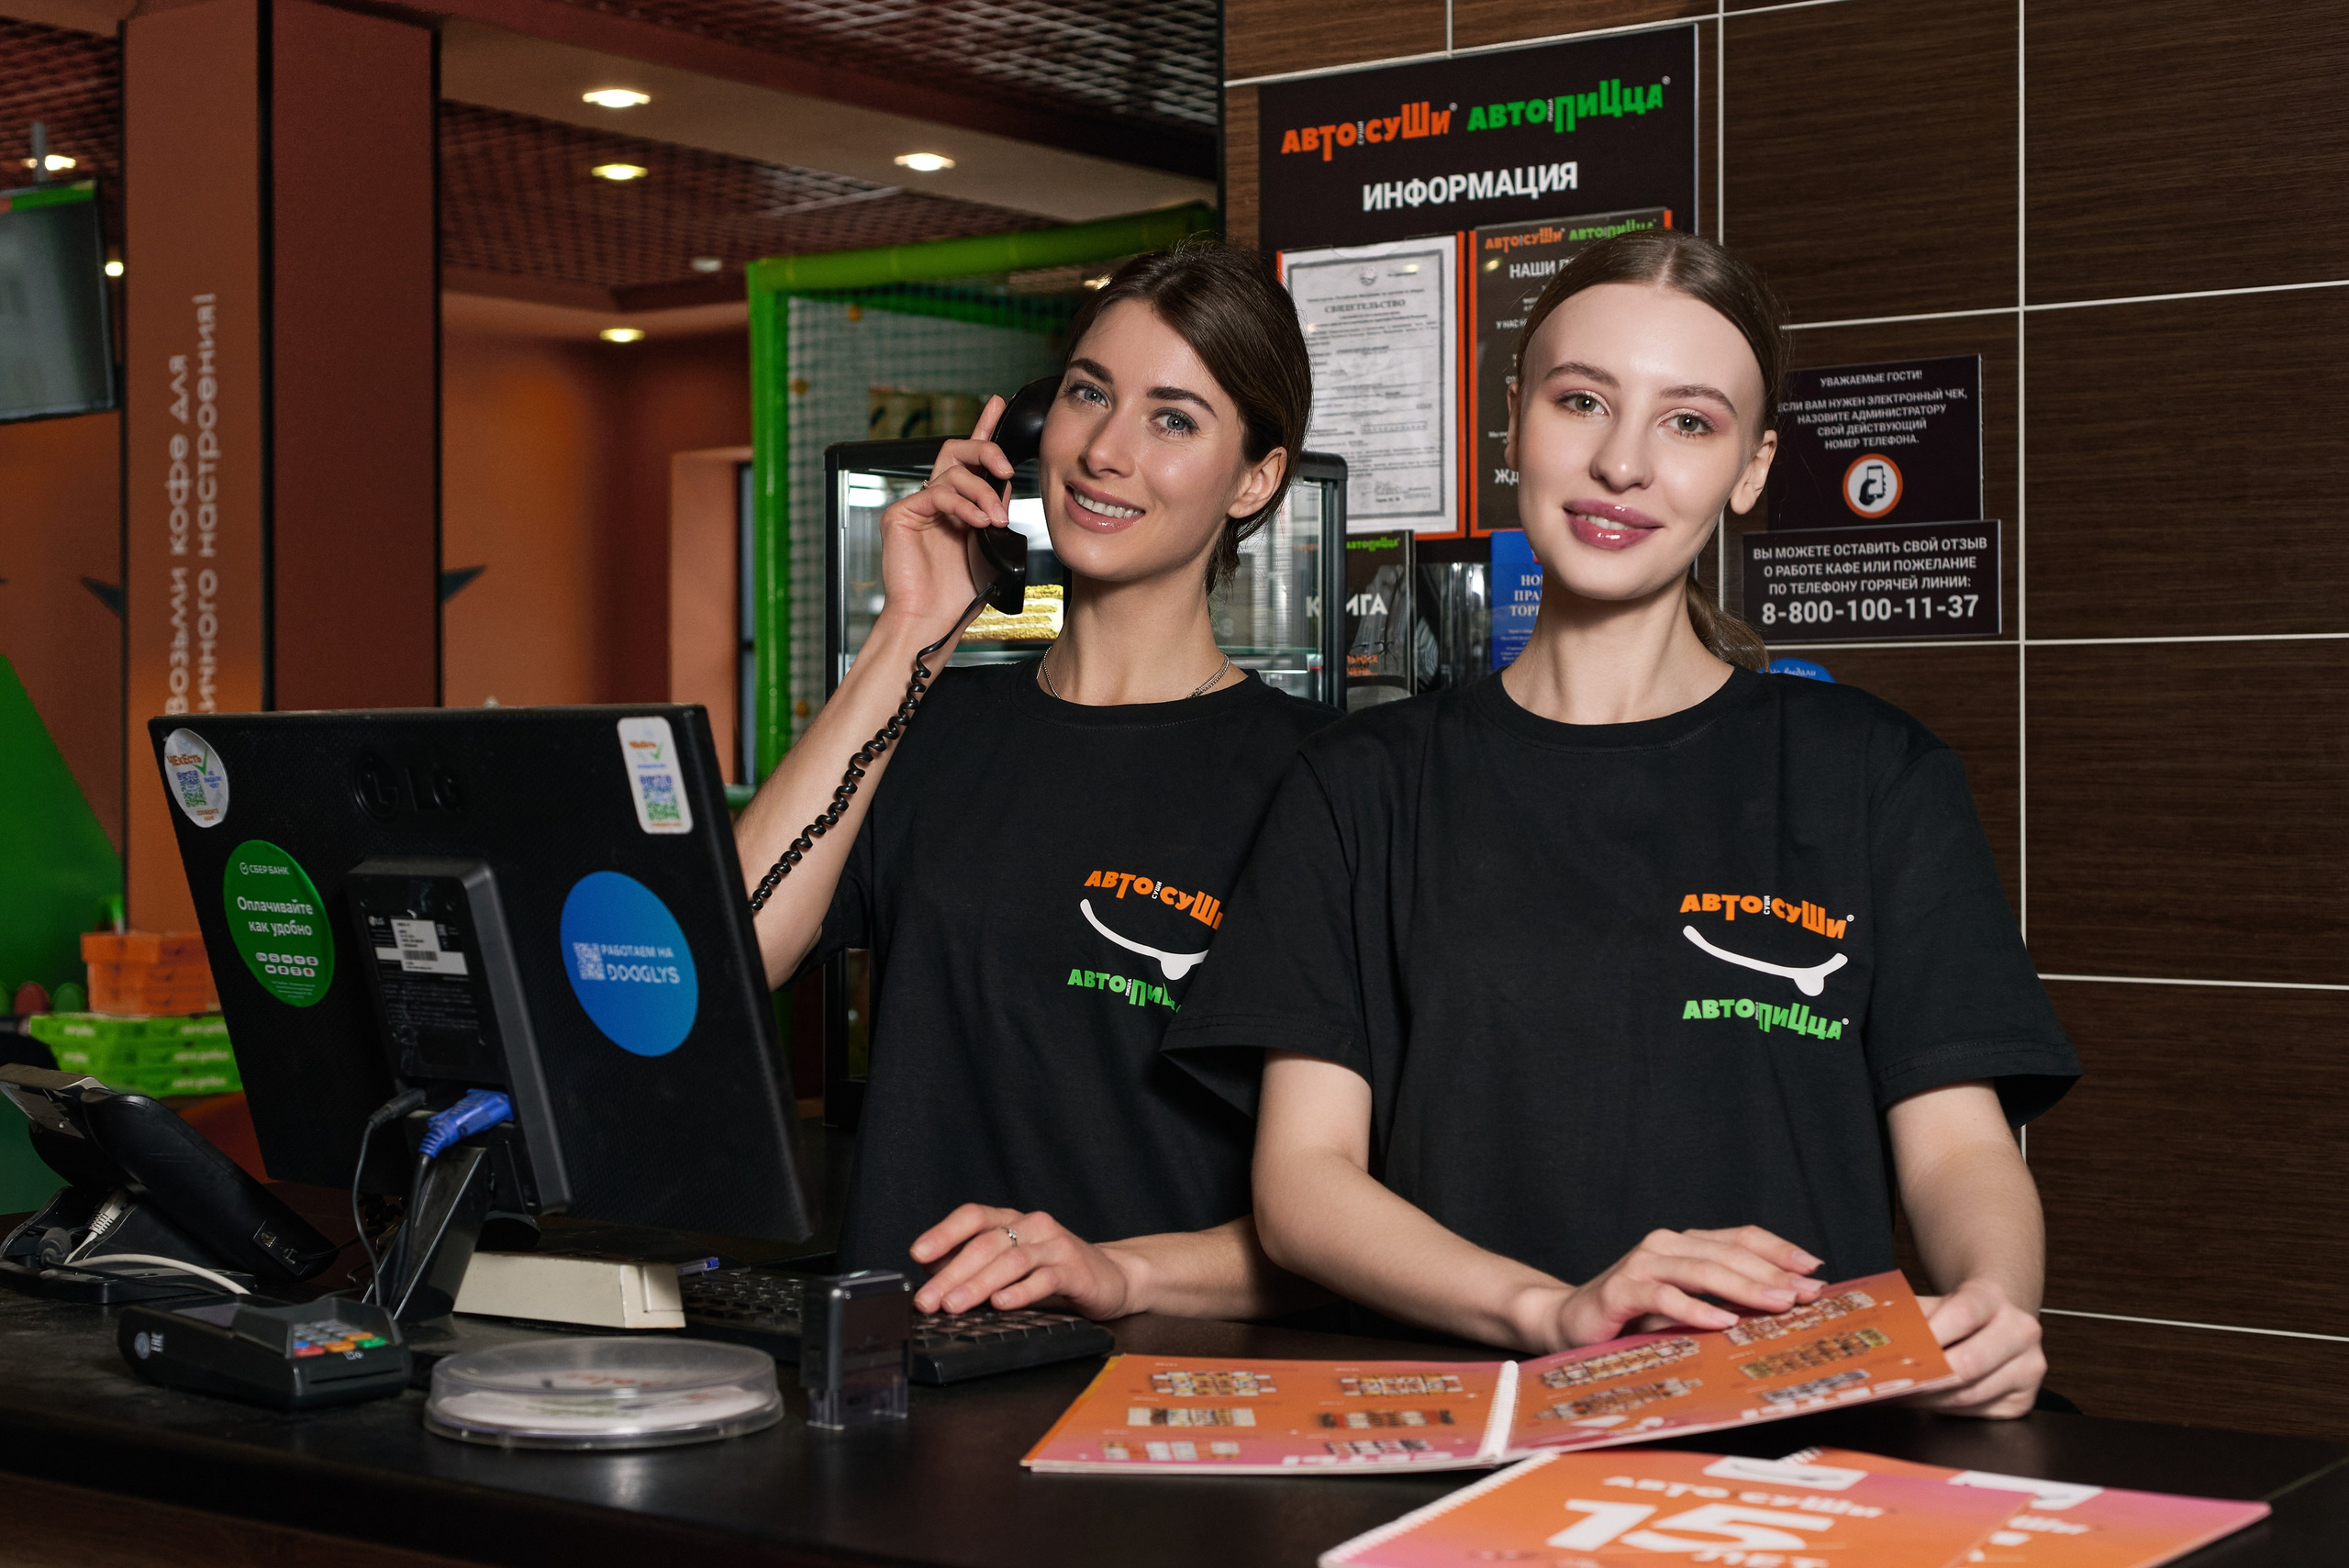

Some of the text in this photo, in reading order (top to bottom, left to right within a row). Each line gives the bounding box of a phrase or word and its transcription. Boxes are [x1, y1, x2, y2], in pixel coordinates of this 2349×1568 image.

[1363, 161, 1579, 211] ИНФОРМАЦИЯ
[169, 354, 188, 425] для
[1820, 370, 1922, 388] УВАЖАЕМЫЕ ГОСТИ!
[1805, 399, 1827, 411] ВАМ
[1829, 396, 1865, 409] НУЖЕН
[1867, 389, 1943, 406] ЭЛЕКТРОННЫЙ
[1945, 388, 1967, 401] ЧЕК,
[1797, 404, 1946, 425] НАЗОВИТЕ АДМИНИСТРАТОРУ
[1817, 417, 1927, 438] СВОЙ ДЕЙСТВУЮЩИЙ
[1824, 434, 1920, 450] НОМЕР ТЕЛЕФОНА.
[164, 433, 193, 556] кофе
[1753, 536, 1987, 561] ВЫ МОЖЕТЕ ОСТАВИТЬ СВОЙ ОТЗЫВ
[1764, 556, 1977, 578] О РАБОТЕ КАФЕ ИЛИ ПОЖЕЛАНИЕ
[1768, 574, 1972, 596] ПО ТЕЛЕФОНУ ГОРЯЧЕЙ ЛИНИИ:
[1762, 595, 1979, 625] 8-800-100-11-37
[237, 896, 314, 916] Оплачивайте
[1084, 870, 1224, 930] АВТОСУШ
[248, 919, 313, 937] как удобно
[1545, 1497, 1835, 1552] 15
